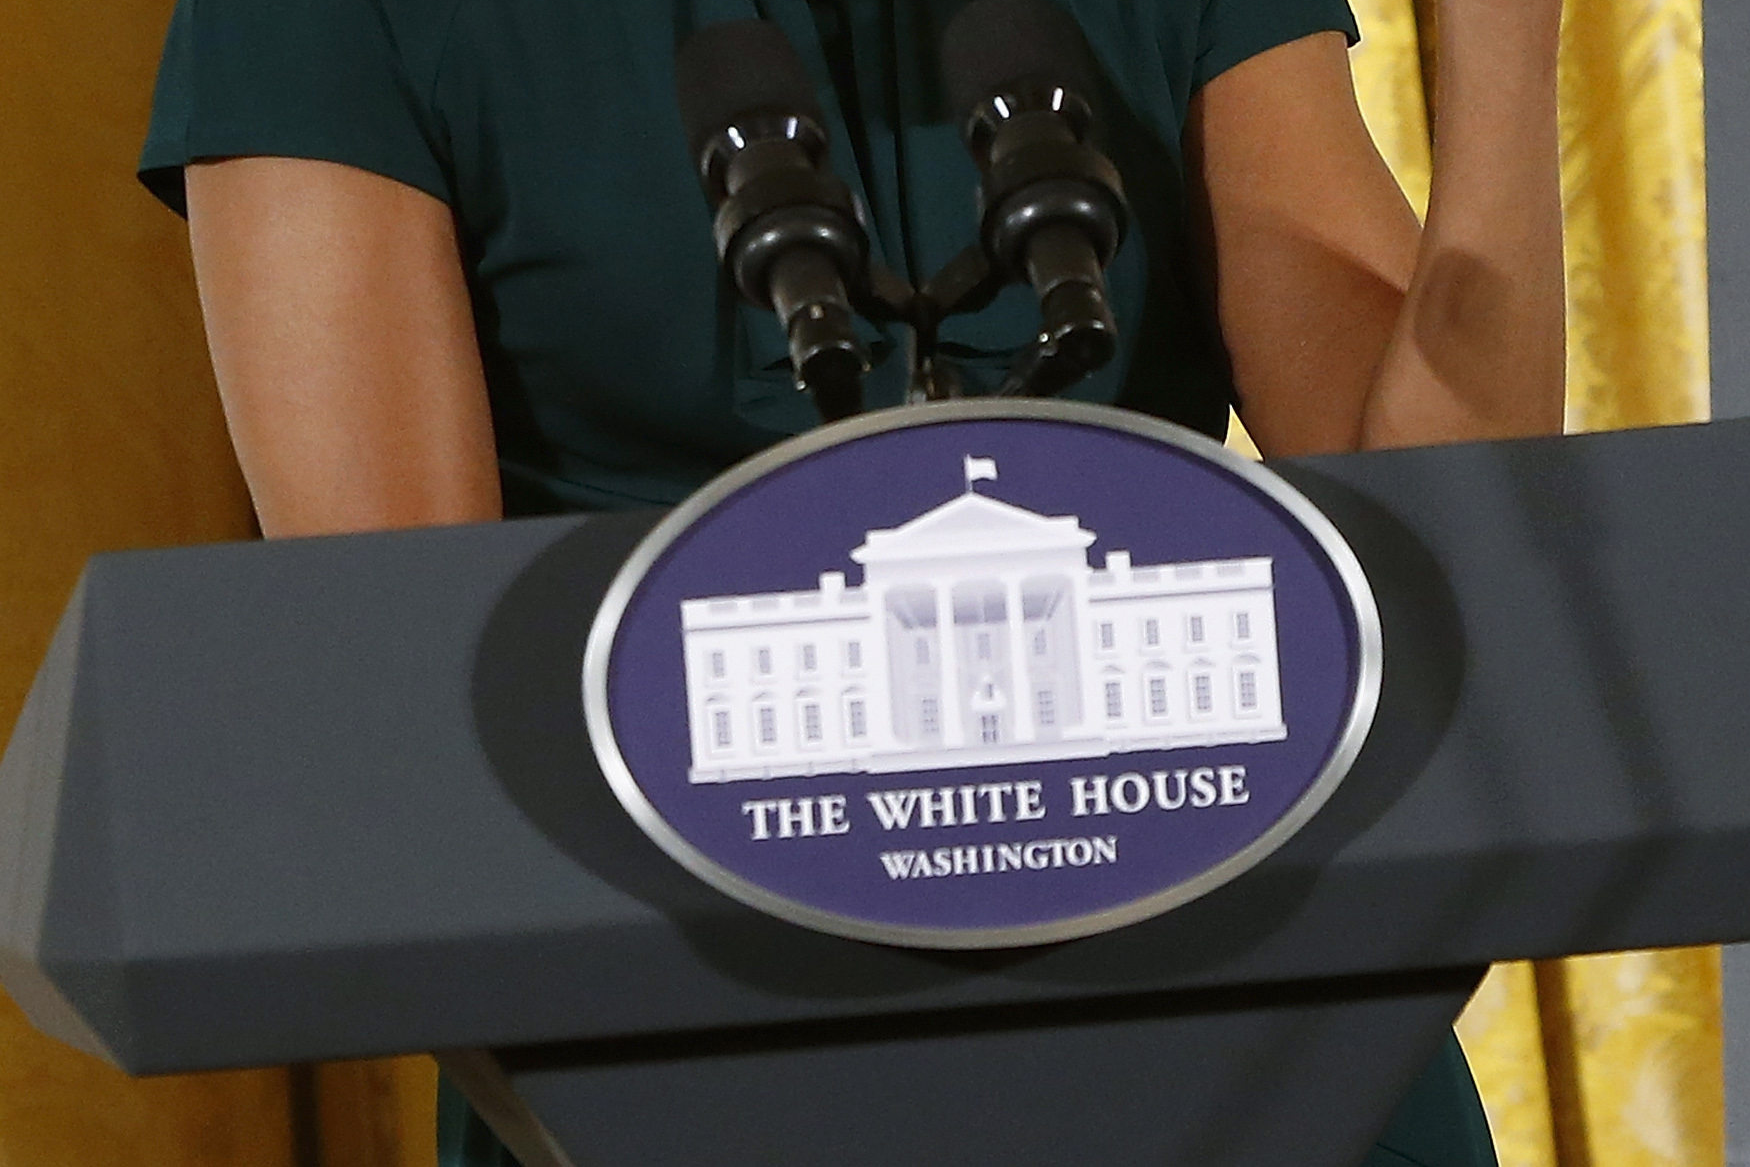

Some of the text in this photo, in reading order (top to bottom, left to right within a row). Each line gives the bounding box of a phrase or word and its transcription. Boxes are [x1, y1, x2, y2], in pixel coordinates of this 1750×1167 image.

[742, 766, 1249, 839] THE WHITE HOUSE
[880, 836, 1116, 879] WASHINGTON
